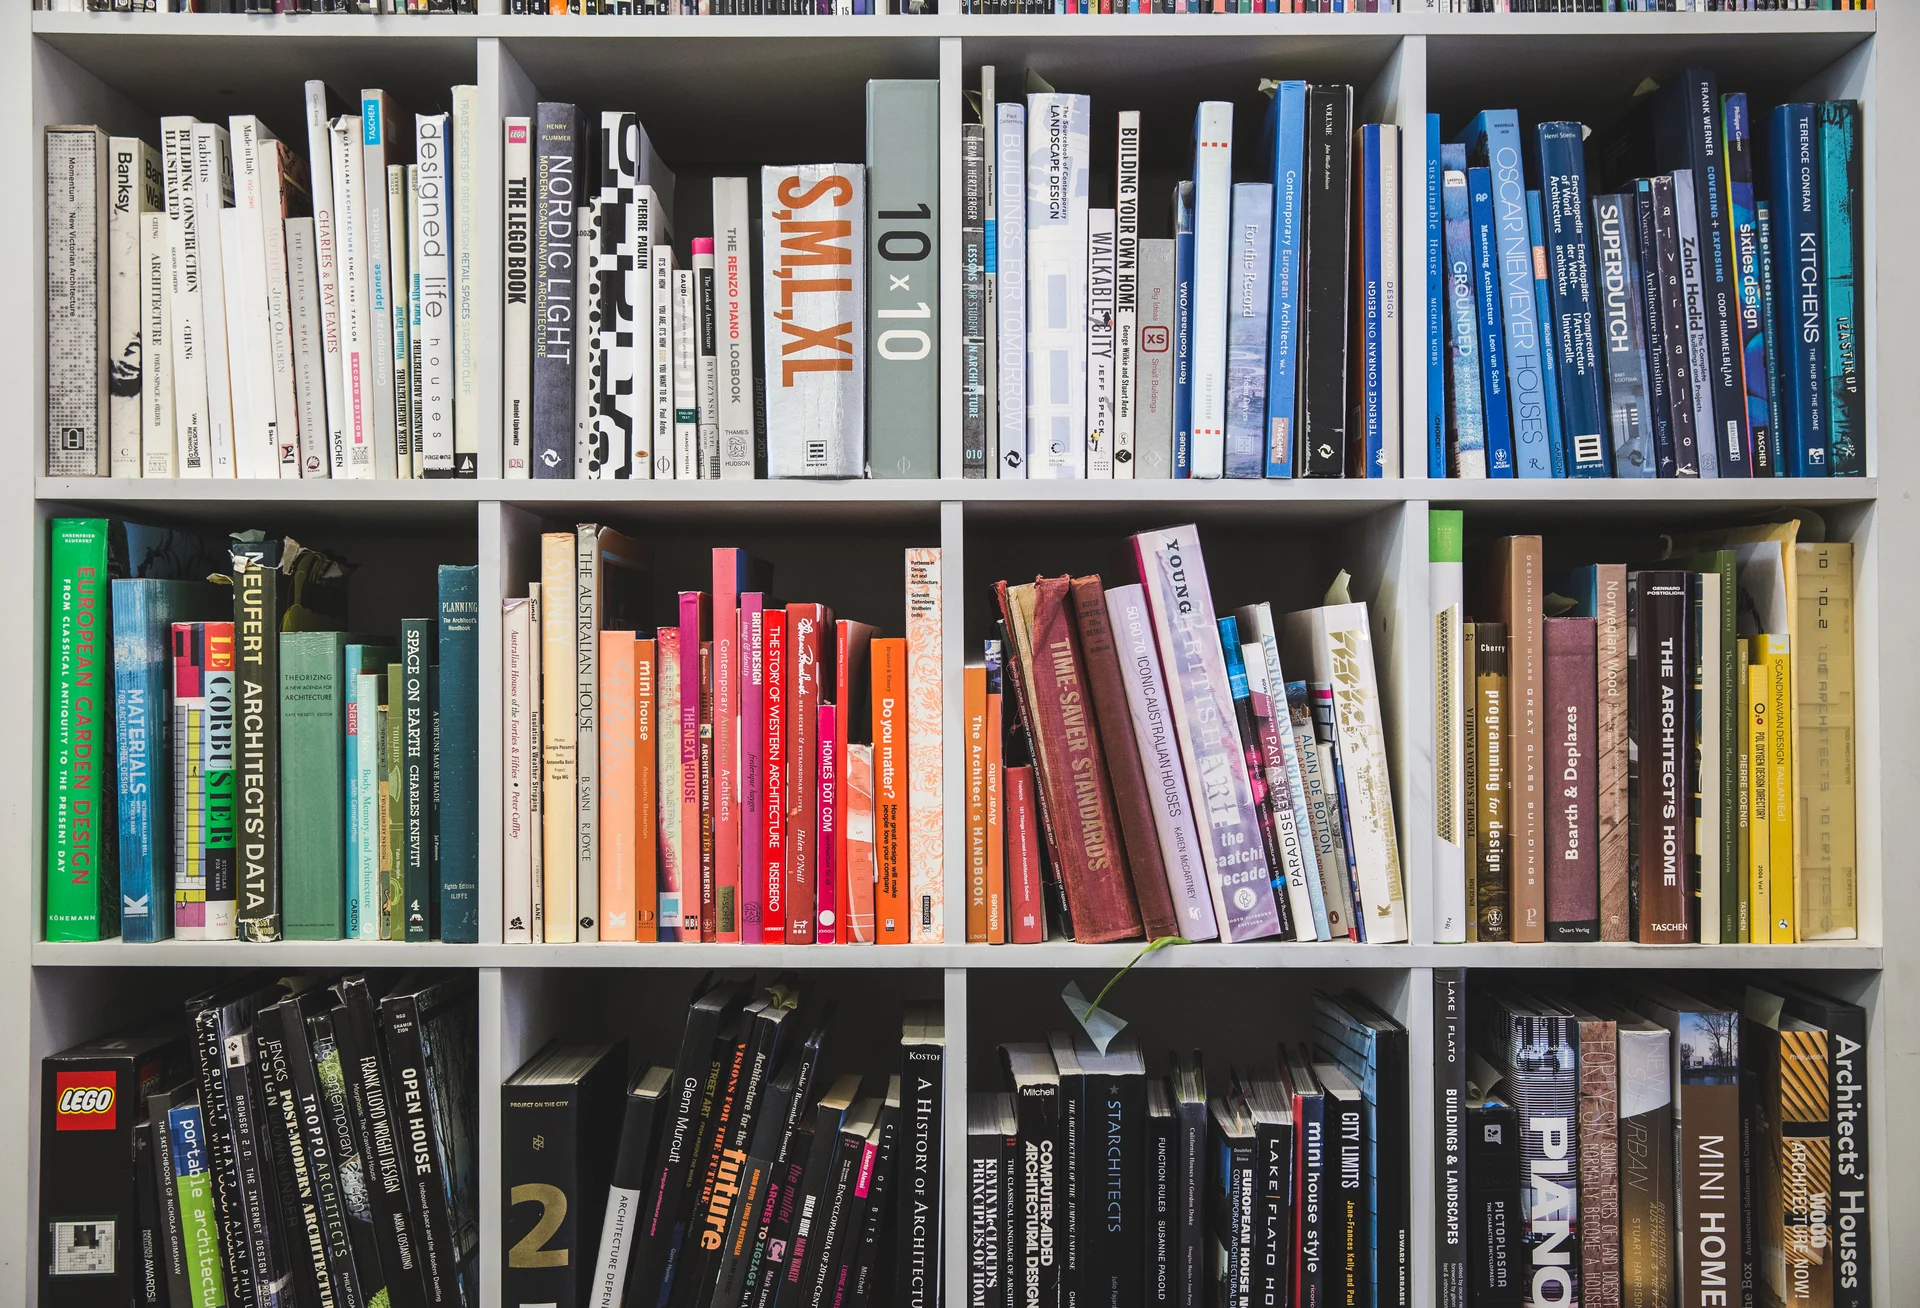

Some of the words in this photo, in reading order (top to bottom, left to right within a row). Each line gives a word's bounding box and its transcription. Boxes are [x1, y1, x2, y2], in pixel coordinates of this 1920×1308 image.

[179, 130, 193, 192] BUILDING
[198, 136, 212, 182] habitus
[1050, 105, 1060, 172] LANDSCAPE
[1120, 128, 1136, 195] BUILDING
[1800, 117, 1809, 164] TERENCE
[114, 152, 132, 212] Banksy
[165, 130, 179, 220] ILLUSTRATED
[417, 124, 445, 258] designed
[508, 178, 526, 208] THE
[539, 156, 548, 200] MODERN
[1049, 175, 1060, 219] DESIGN
[1497, 147, 1522, 232] OSCAR
[1801, 167, 1811, 212] CONRAN
[508, 212, 526, 253] LEGO
[548, 155, 572, 269] NORDIC
[637, 198, 648, 232] PIERRE
[877, 202, 931, 261] 10
[1120, 199, 1135, 234] YOUR
[1281, 171, 1296, 246] Contemporary
[184, 197, 197, 293] CONSTRUCTION
[319, 210, 333, 267] CHARLES
[538, 202, 547, 278] SCANDINAVIAN
[637, 235, 648, 269] PAULIN
[727, 228, 737, 251] THE
[1119, 238, 1134, 270] OWN
[1244, 248, 1257, 268] the
[1245, 223, 1258, 245] For
[1739, 224, 1756, 274] sixties
[508, 257, 526, 304] BOOK
[728, 256, 737, 297] RENZO
[772, 175, 853, 387] S,M,L,XL
[889, 274, 910, 291] x
[1280, 249, 1292, 298] European
[1600, 205, 1628, 352] SUPERDUTCH
[1682, 237, 1698, 280] Zaha
[69, 268, 77, 316] Architecture
[324, 284, 335, 308] RAY
[424, 277, 446, 318] life
[1118, 274, 1134, 313] HOME
[1242, 272, 1256, 317] Record
[1453, 261, 1471, 356] GROUNDED
[1503, 237, 1534, 349] NIEMEYER
[1685, 283, 1703, 331] Hadid
[1741, 276, 1759, 329] design
[1800, 232, 1819, 343] KITCHENS
[326, 312, 337, 353] EAMES
[537, 281, 546, 358] ARCHITECTURE
[546, 278, 571, 364] LIGHT
[729, 301, 738, 338] PIANO
[877, 301, 931, 360] 10
[1279, 303, 1290, 355] Architects
[429, 338, 443, 438] houses
[730, 343, 741, 403] LOGBOOK
[1811, 381, 1817, 391] OF
[1516, 354, 1543, 444] HOUSES
[1276, 423, 1284, 457] TASCHEN
[1757, 431, 1767, 466] TASCHEN
[580, 550, 593, 579] THE
[1167, 539, 1193, 615] YOUNG
[74, 566, 95, 687] EUROPEAN
[580, 585, 592, 675] AUSTRALIAN
[769, 626, 780, 648] THE
[1604, 580, 1619, 654] Norwegian
[210, 635, 232, 667] LE
[407, 630, 420, 674] SPACE
[769, 650, 780, 685] STORY
[1661, 638, 1674, 677] THE
[408, 679, 420, 701] ON
[769, 687, 780, 702] OF
[1607, 659, 1620, 697] Wood
[348, 703, 360, 734] Starck
[580, 683, 592, 732] HOUSE
[882, 698, 895, 716] Do
[73, 697, 92, 789] GARDEN
[127, 689, 146, 794] MATERIALS
[408, 707, 421, 757] EARTH
[768, 705, 780, 760] WESTERN
[880, 719, 892, 744] you
[1050, 638, 1088, 752] TIME-SAVER
[1071, 758, 1109, 871] STANDARDS
[1302, 734, 1319, 776] ALAIN
[1484, 690, 1502, 791] programming
[1661, 685, 1675, 819] ARCHITECT'S
[210, 676, 233, 844] CORBUSIER
[822, 741, 832, 779] HOMES
[882, 746, 896, 798] matter?
[1740, 754, 1748, 788] PIERRE
[409, 765, 420, 816] CHARLES
[768, 764, 780, 847] ARCHITECTURE
[822, 783, 832, 802] DOT
[1308, 780, 1322, 799] DE
[1489, 797, 1501, 815] for
[1740, 791, 1748, 827] KOENIG
[71, 800, 90, 885] DESIGN
[409, 819, 420, 867] KNEVITT
[822, 806, 832, 832] COM
[1312, 801, 1332, 854] BOTTON
[1486, 821, 1503, 872] design
[1664, 825, 1676, 886] HOME
[769, 862, 780, 912] RISEBERO
[360, 1056, 380, 1089] FRANK
[402, 1068, 422, 1114] OPEN
[679, 1077, 697, 1114] Glenn
[58, 1087, 114, 1114] LEGO
[367, 1091, 385, 1119] LLOYD
[1446, 1089, 1458, 1151] BUILDINGS
[1835, 1034, 1864, 1180] Architects'
[158, 1120, 166, 1135] THE
[372, 1121, 393, 1156] WRIGHT
[410, 1118, 431, 1175] HOUSE
[669, 1116, 689, 1163] Murcutt
[1307, 1122, 1322, 1167] mini
[161, 1136, 171, 1185] SKETCHBOOKS
[180, 1119, 205, 1198] portable
[302, 1094, 326, 1158] TROPPO
[316, 1163, 347, 1258] ARCHITECTS
[379, 1158, 400, 1194] DESIGN
[859, 1172, 868, 1188] Alessi
[862, 1150, 872, 1171] Alberto
[1107, 1100, 1121, 1232] STARCHITECTS
[1158, 1137, 1166, 1181] FUNCTION
[1447, 1155, 1457, 1164] &
[1698, 1135, 1724, 1199] MINI
[166, 1188, 172, 1196] OF
[701, 1148, 747, 1250] future
[1025, 1141, 1038, 1254] ARCHITECTURAL
[1040, 1140, 1053, 1266] COMPUTER-AIDED
[1308, 1173, 1321, 1223] house
[1447, 1171, 1459, 1244] LANDSCAPES
[167, 1199, 176, 1234] NICHOLAS
[509, 1183, 568, 1268] 2
[1839, 1191, 1865, 1289] Houses
[171, 1236, 181, 1275] GRIMSHAW
[1158, 1220, 1166, 1262] SUSANNE
[1306, 1230, 1321, 1272] style
[1494, 1201, 1507, 1287] PICTOPLASMA
